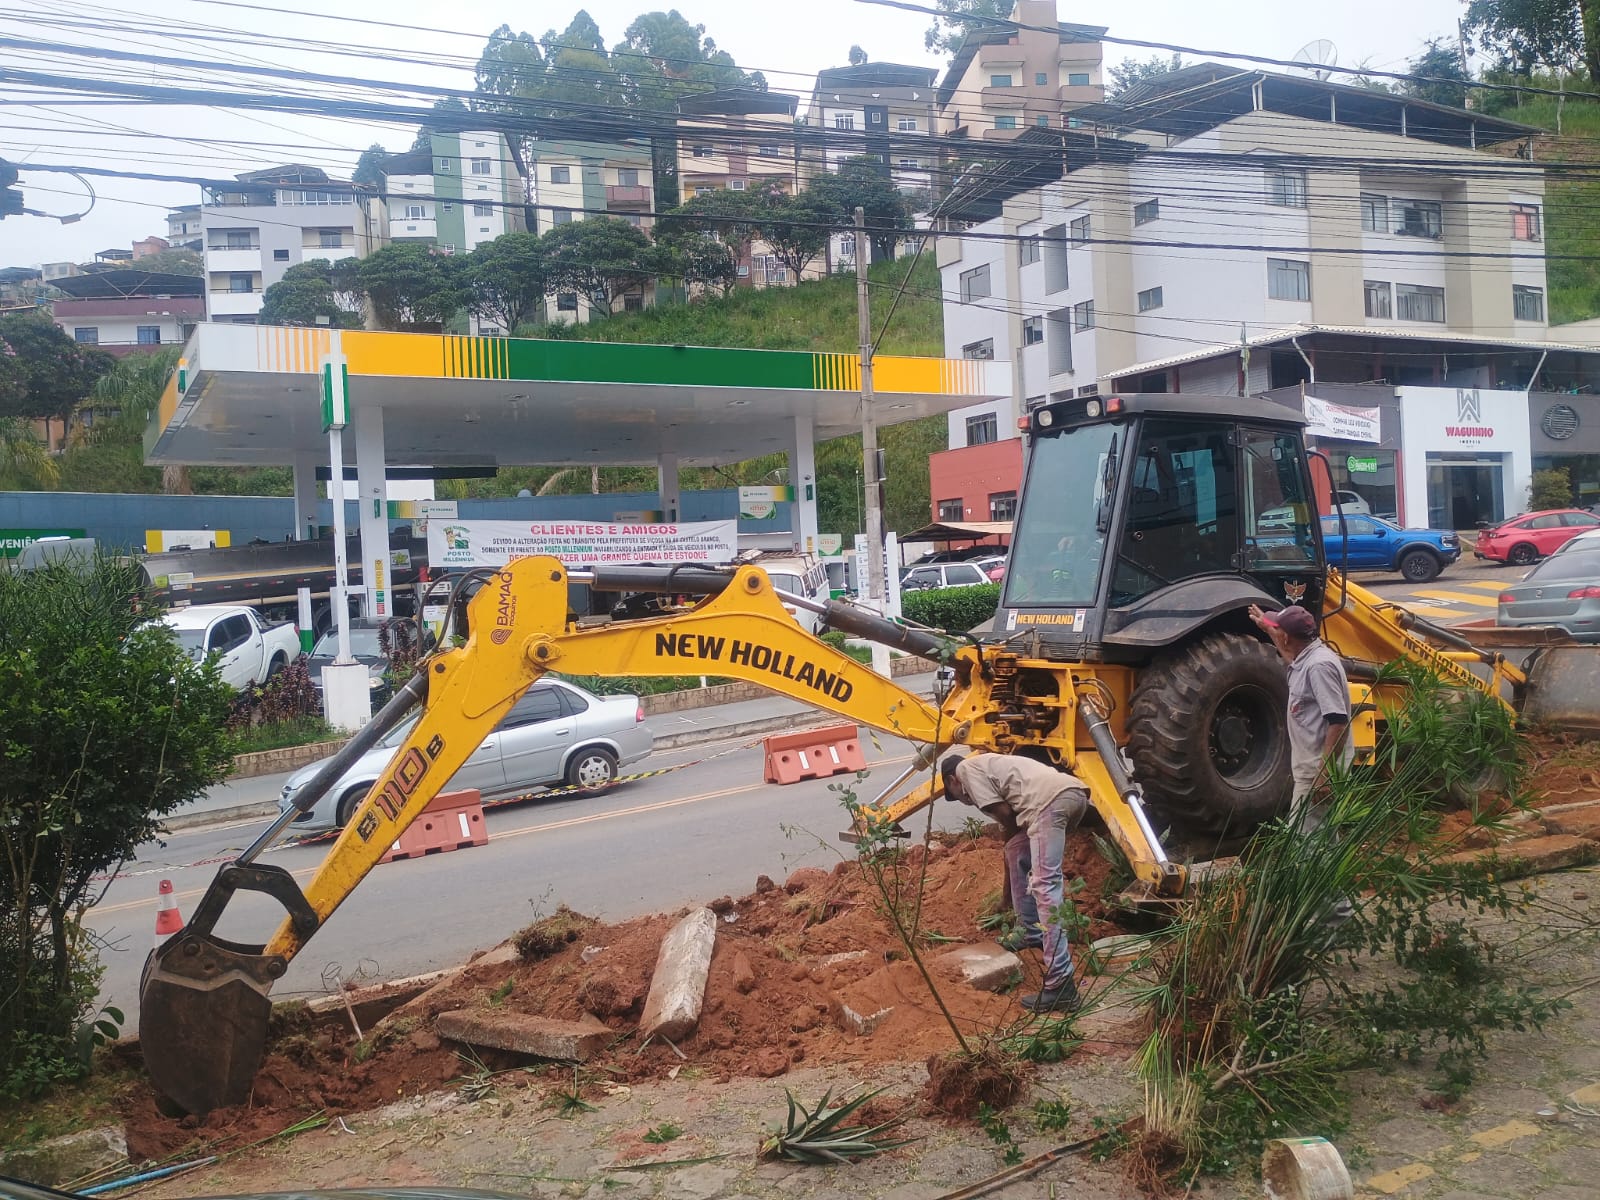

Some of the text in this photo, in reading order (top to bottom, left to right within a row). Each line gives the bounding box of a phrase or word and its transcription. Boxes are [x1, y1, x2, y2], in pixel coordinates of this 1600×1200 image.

[1446, 426, 1494, 438] WAGUINHO
[530, 524, 678, 535] CLIENTES E AMIGOS
[517, 537, 547, 546] ALTERAÇÃO
[581, 554, 598, 562] UMA
[601, 553, 634, 561] GRANDE
[634, 552, 662, 561] QUEIMA
[663, 552, 673, 560] DE
[675, 551, 708, 560] ESTOQUE
[496, 571, 513, 626] BAMAQ
[1017, 614, 1035, 625] NEW
[1036, 614, 1074, 625] HOLLAND
[1403, 638, 1431, 661] NEW
[655, 633, 853, 703] NEW HOLLAND
